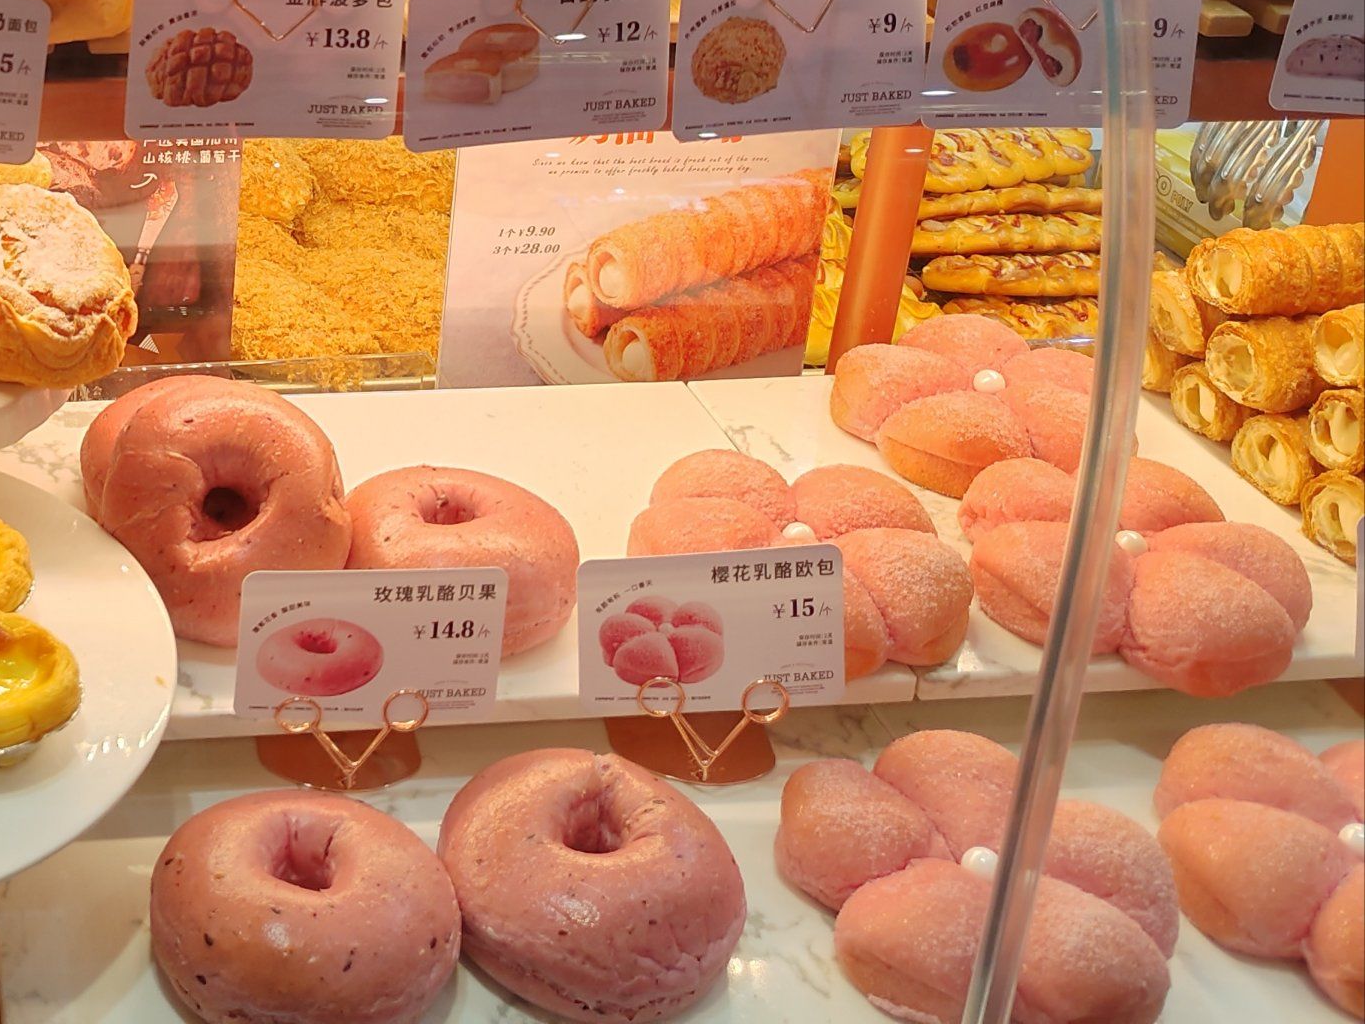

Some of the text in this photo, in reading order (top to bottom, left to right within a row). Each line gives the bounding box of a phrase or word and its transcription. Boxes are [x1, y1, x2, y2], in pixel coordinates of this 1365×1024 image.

[840, 90, 912, 103] JUST BAKED
[307, 105, 339, 115] JUST
[583, 97, 657, 112] JUST BAKED
[143, 149, 241, 164] 山核桃、葡萄干
[711, 558, 834, 584] 樱花乳酪欧包
[373, 583, 496, 603] 玫瑰乳酪贝果
[793, 670, 834, 682] BAKED
[446, 688, 487, 698] BAKED
